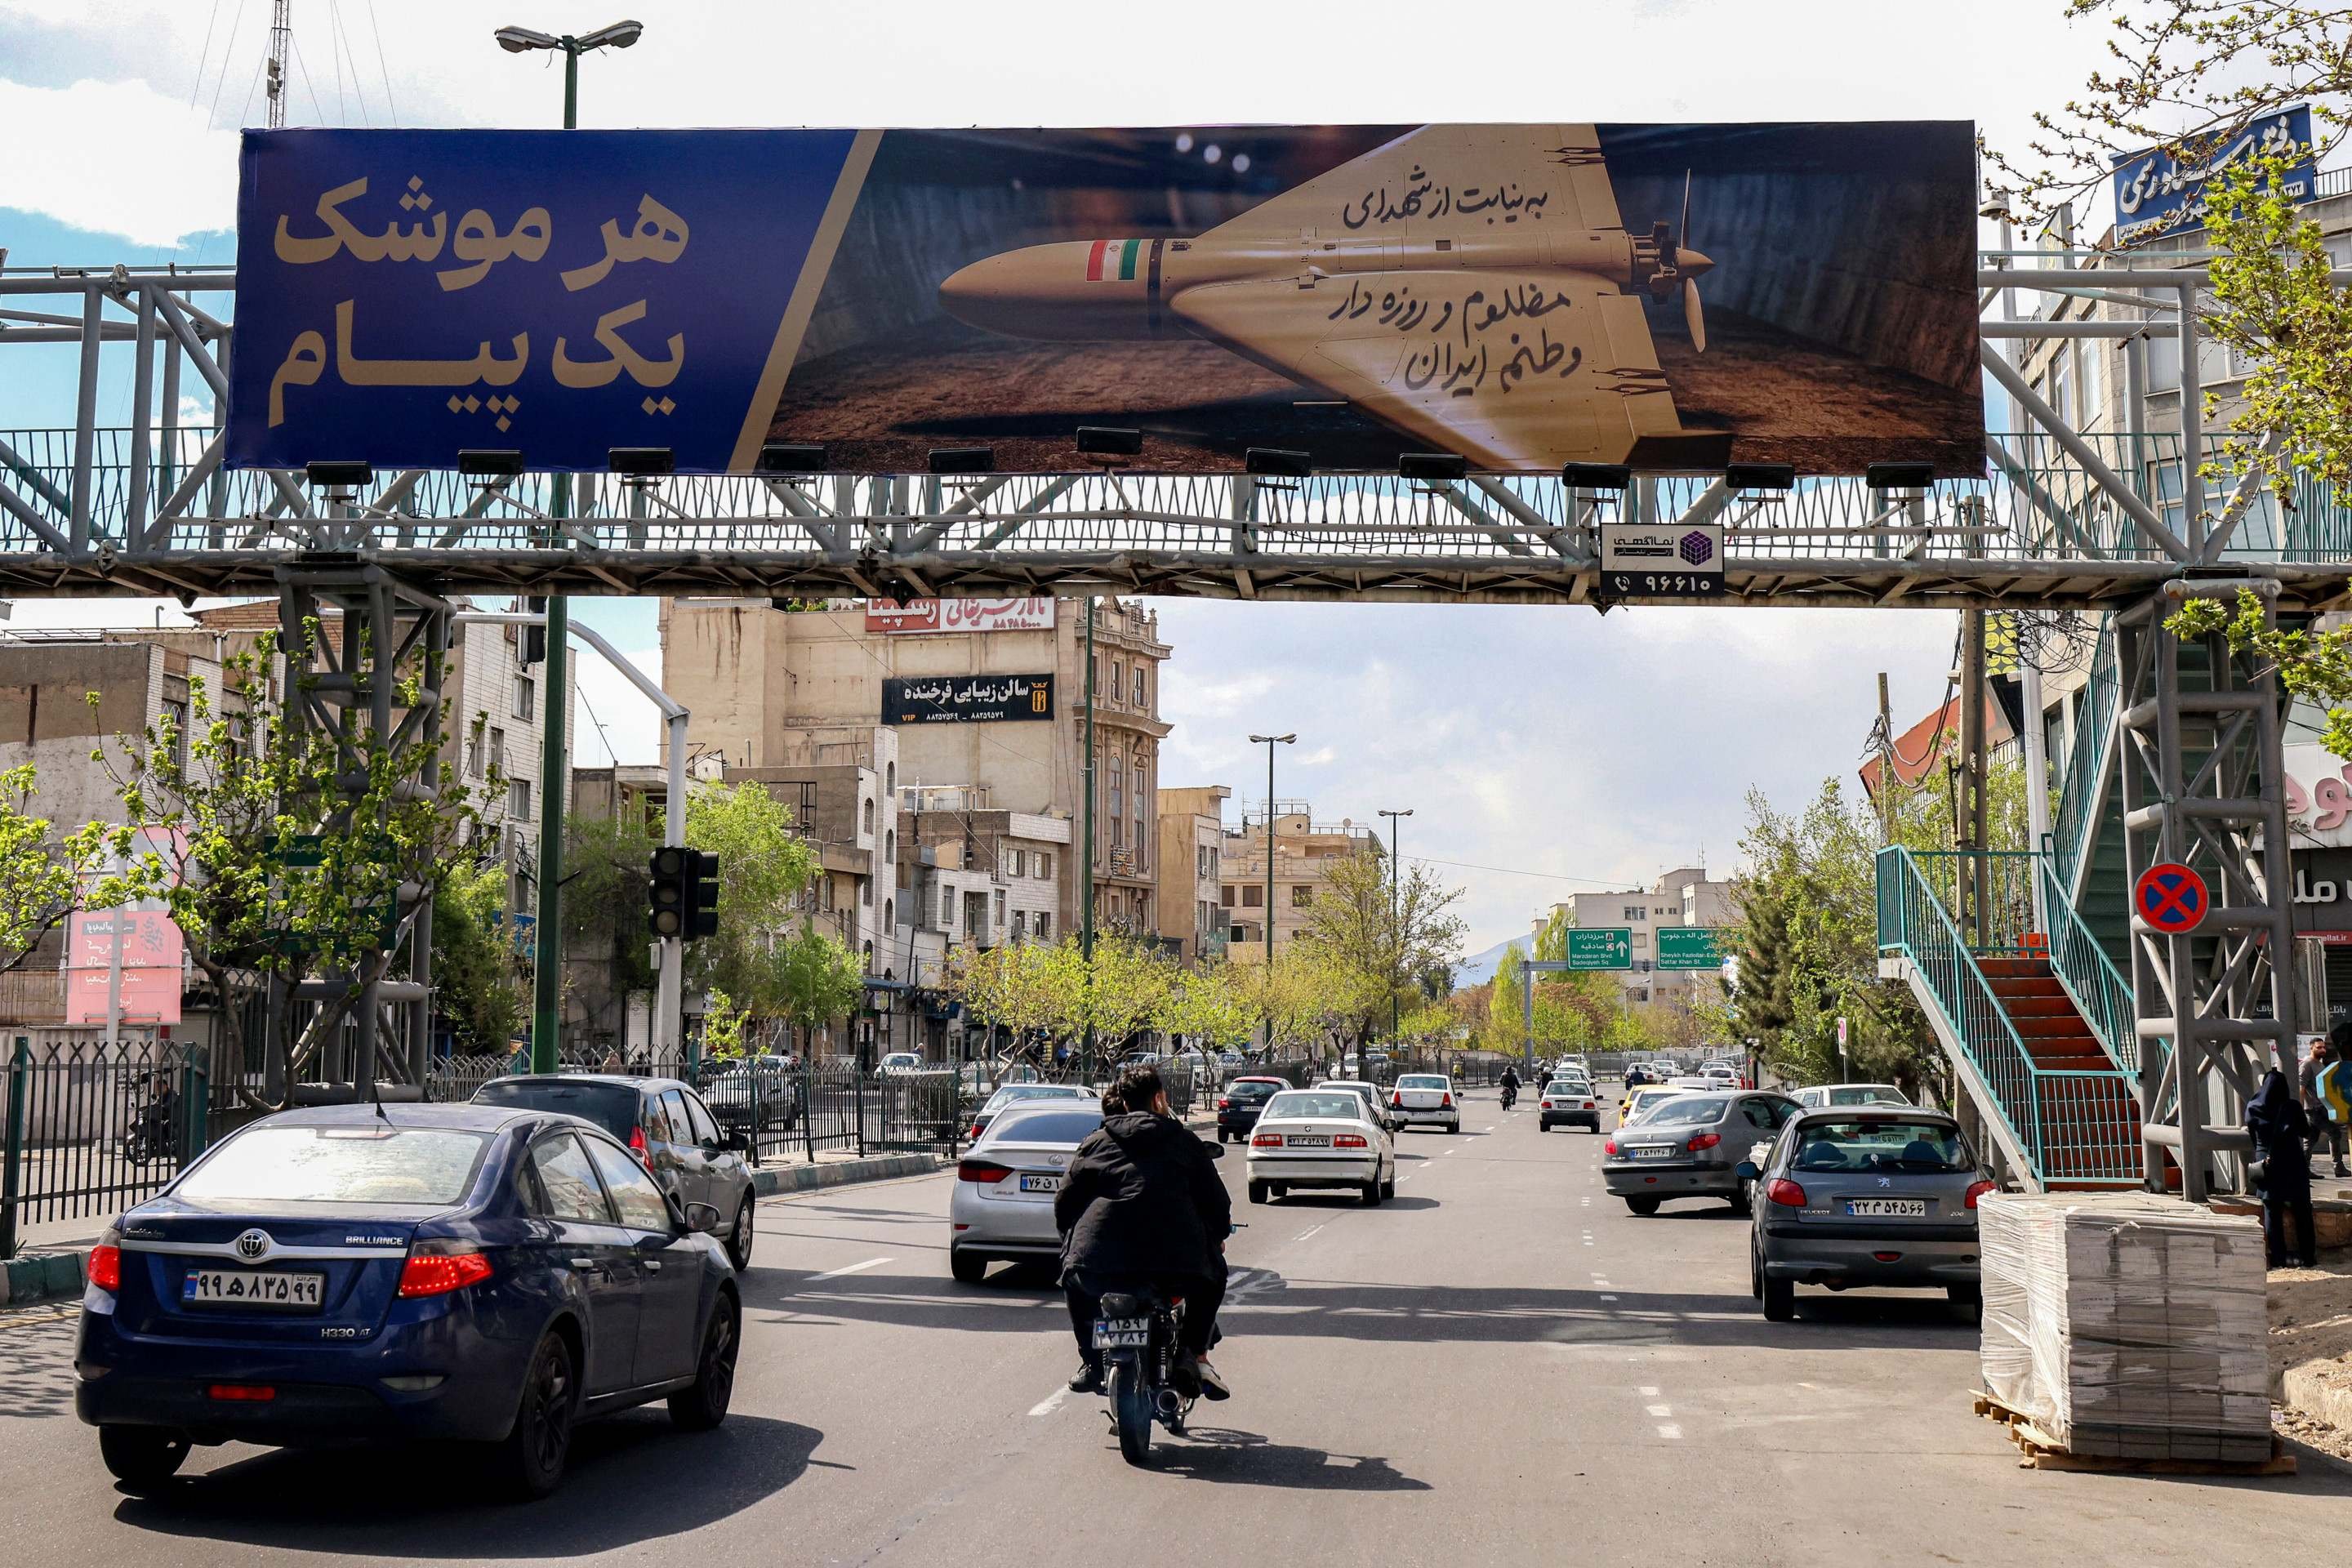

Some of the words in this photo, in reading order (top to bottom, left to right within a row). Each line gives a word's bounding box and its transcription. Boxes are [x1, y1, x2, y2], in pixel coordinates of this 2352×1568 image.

[1343, 164, 1432, 229] شهدای
[1427, 185, 1450, 220] از
[1455, 183, 1526, 225] نیابت
[1524, 191, 1548, 220] به
[274, 174, 553, 292] موشک
[560, 192, 690, 292] هر
[1462, 283, 1571, 349] مظلوم
[268, 298, 530, 434] پیام
[550, 298, 684, 416] یک
[1404, 341, 1487, 399] ایران
[1646, 576, 1711, 592] ۹۶۶۱۰
[903, 679, 952, 705] فرخنده
[954, 679, 996, 704] زیبایی
[997, 678, 1029, 702] سالن
[2290, 869, 2337, 903] مل
[1575, 933, 1605, 941] مرزداران
[1580, 942, 1605, 951] صادقیه
[1660, 933, 1681, 941] جنوب
[1028, 1178, 1040, 1188] ۷۶
[1043, 1178, 1052, 1189] ق
[1855, 1201, 1869, 1214] ۲۲
[1884, 1201, 1908, 1214] ۵۴۵
[1909, 1204, 1924, 1214] ۶۶
[345, 1236, 403, 1245] BRILLIANCE
[198, 1274, 222, 1298] ۹۹
[248, 1276, 289, 1300] ۸۳۵
[293, 1282, 317, 1303] ۹۹
[321, 1328, 355, 1338] H330
[359, 1328, 372, 1336] AT
